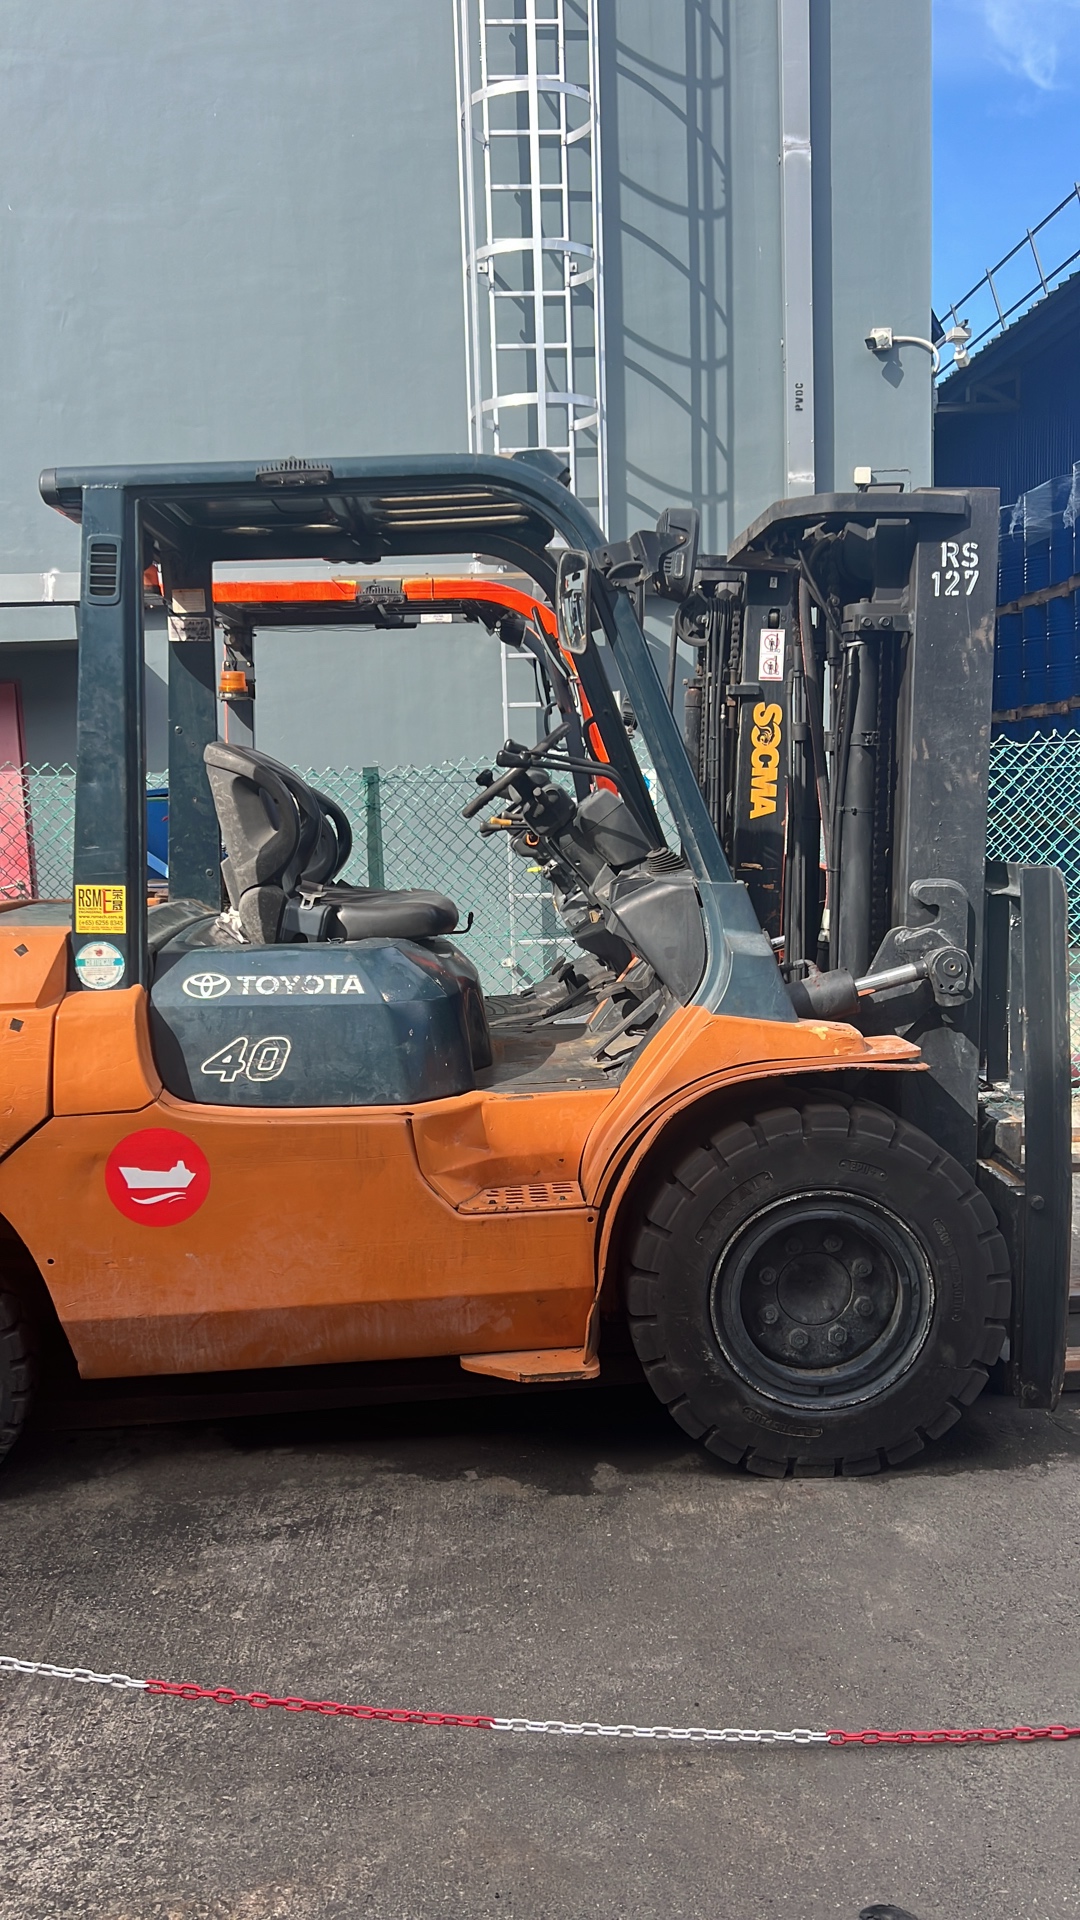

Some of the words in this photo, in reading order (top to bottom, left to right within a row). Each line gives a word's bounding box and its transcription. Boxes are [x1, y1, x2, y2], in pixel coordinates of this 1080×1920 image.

[795, 383, 804, 412] PVDC
[940, 541, 979, 568] RS
[931, 570, 980, 597] 127
[750, 702, 783, 819] SOCMA
[237, 975, 365, 995] TOYOTA
[201, 1036, 292, 1083] 40
